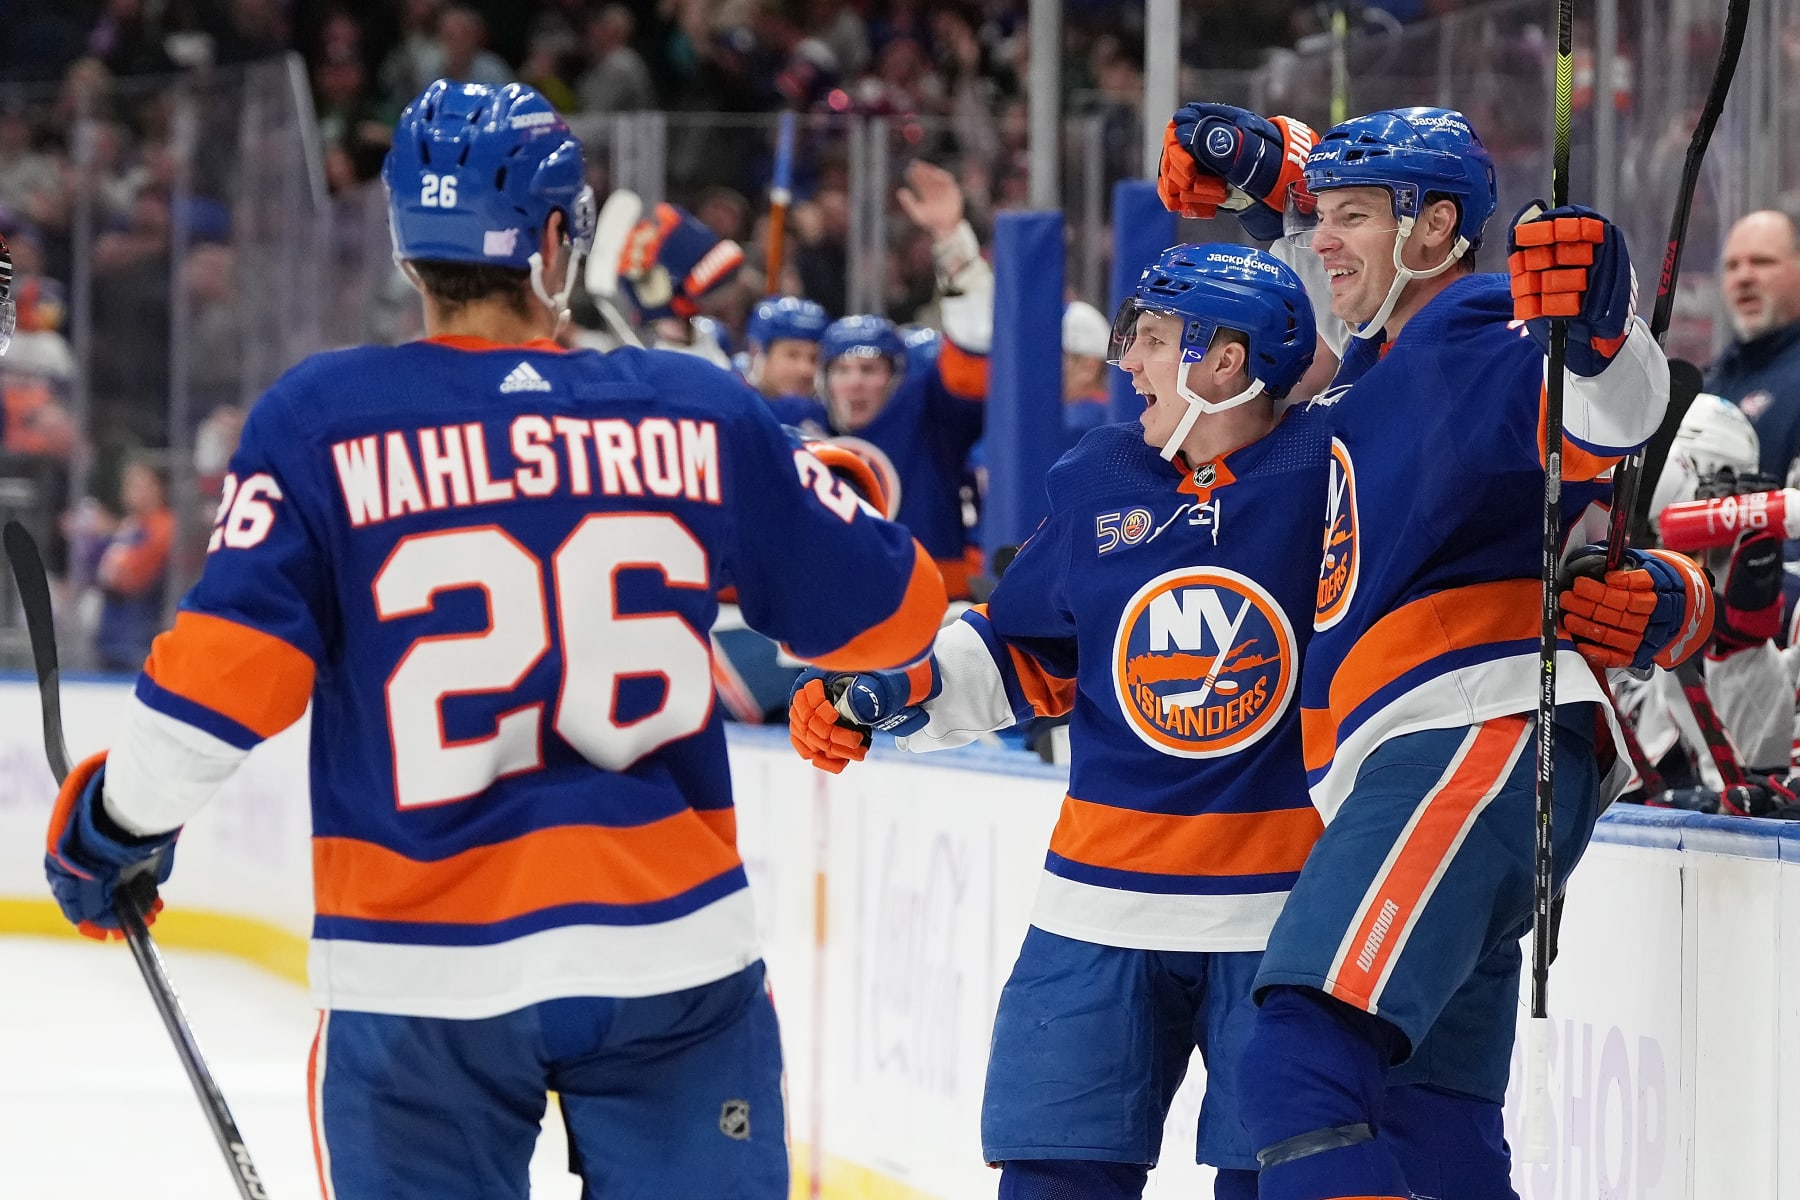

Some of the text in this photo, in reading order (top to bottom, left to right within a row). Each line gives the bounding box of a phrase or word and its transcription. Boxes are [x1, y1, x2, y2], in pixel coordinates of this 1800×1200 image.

[1307, 151, 1338, 164] CCM
[420, 173, 458, 209] 26
[1206, 253, 1279, 277] Jackpocket
[331, 414, 722, 528] WAHLSTROM
[1096, 508, 1152, 554] 50
[1149, 588, 1252, 653] NY
[371, 511, 715, 811] 26
[1134, 675, 1268, 737] ISLANDERS
[1542, 659, 1553, 782] WARRIOR ALPHA LX
[1355, 897, 1400, 974] WARRIOR
